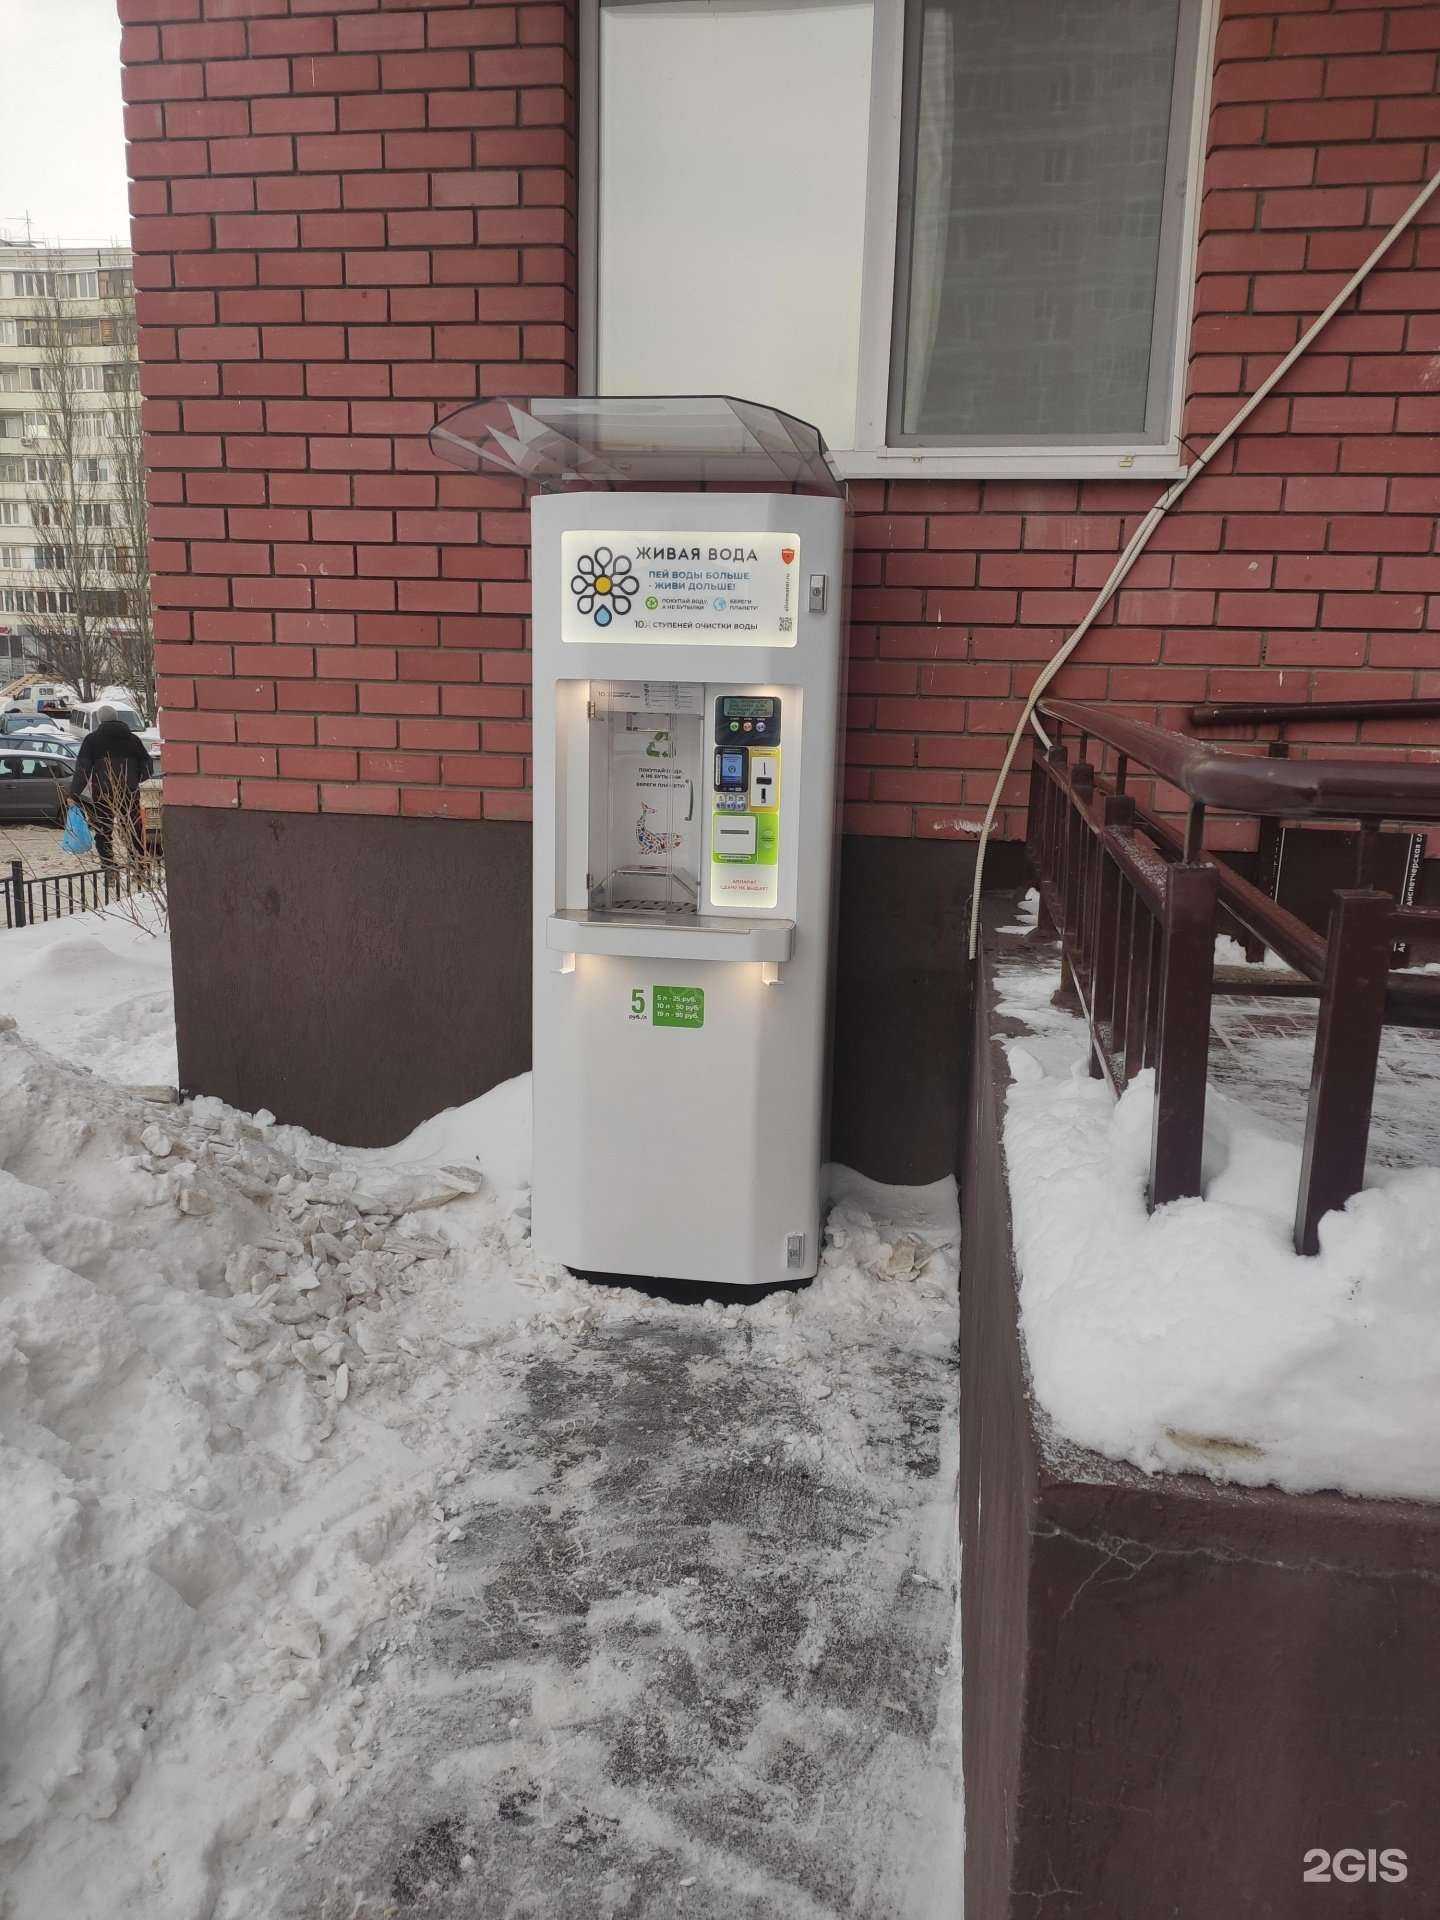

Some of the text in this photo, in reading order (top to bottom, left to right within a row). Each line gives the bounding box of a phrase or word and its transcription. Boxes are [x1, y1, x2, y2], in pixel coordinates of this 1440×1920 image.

[636, 547, 758, 562] ЖИВАЯ ВОДА
[648, 569, 752, 580] ПЕЙ ВОДЫ БОЛЬШЕ
[654, 582, 686, 590] ЖИВИ
[687, 583, 736, 591] ДОЛЬШЕ!
[652, 621, 692, 629] СТУПЕНЕЙ
[695, 622, 732, 630] ОЧИСТКИ
[631, 988, 645, 1013] 5
